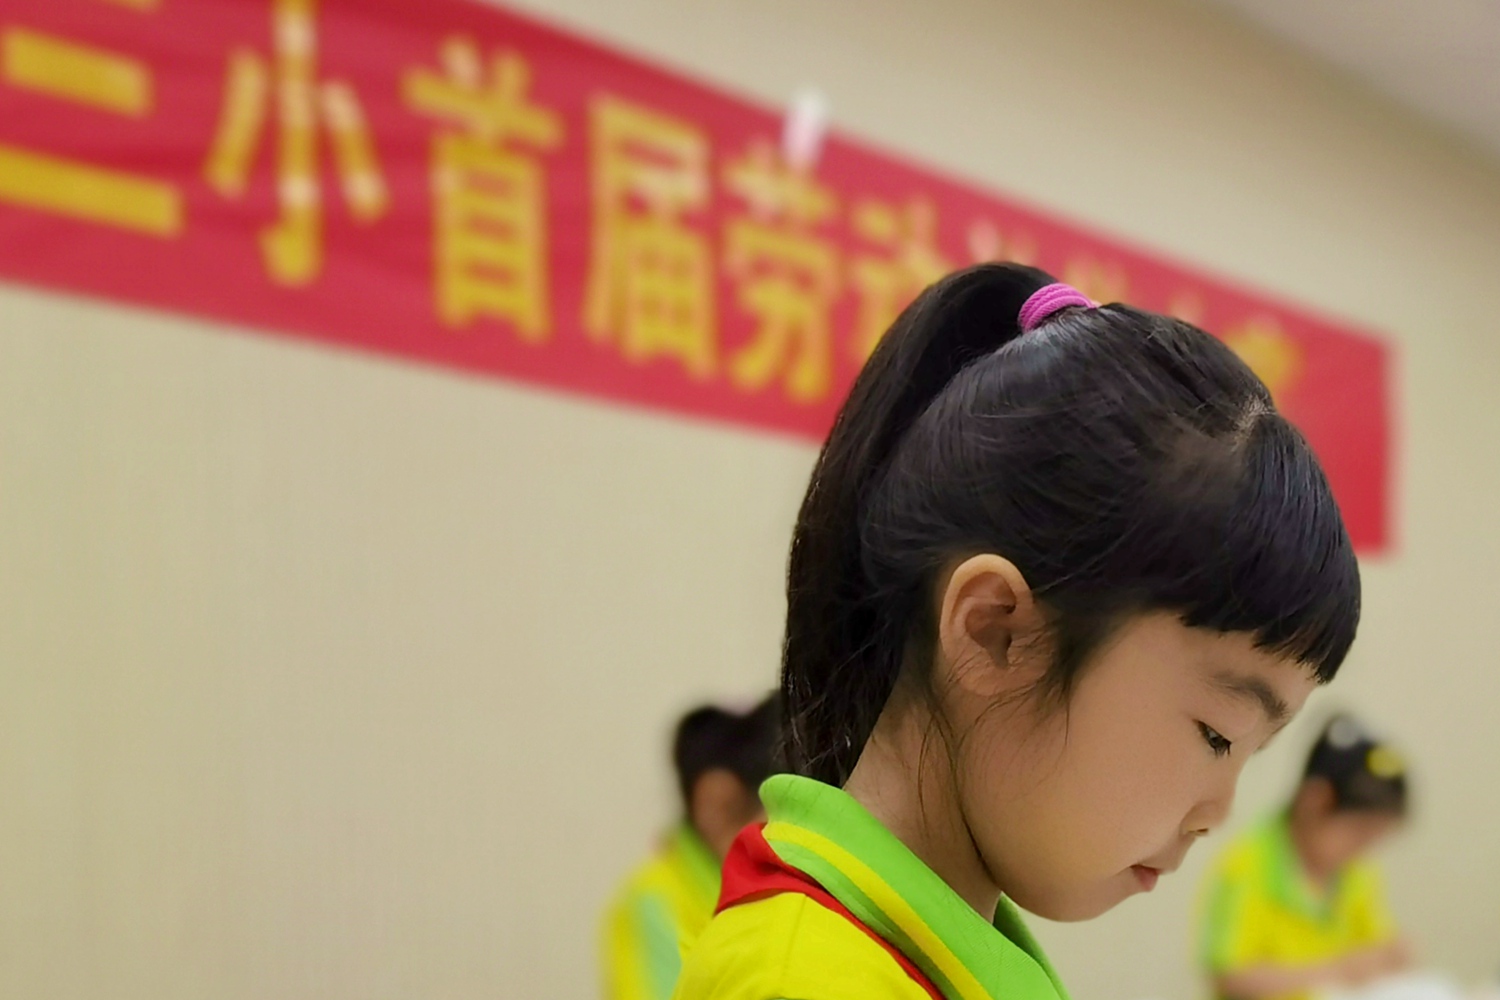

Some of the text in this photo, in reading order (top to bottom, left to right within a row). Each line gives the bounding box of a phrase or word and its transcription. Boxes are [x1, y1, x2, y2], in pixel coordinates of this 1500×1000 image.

[0, 0, 1300, 402] 三小首届劳动
